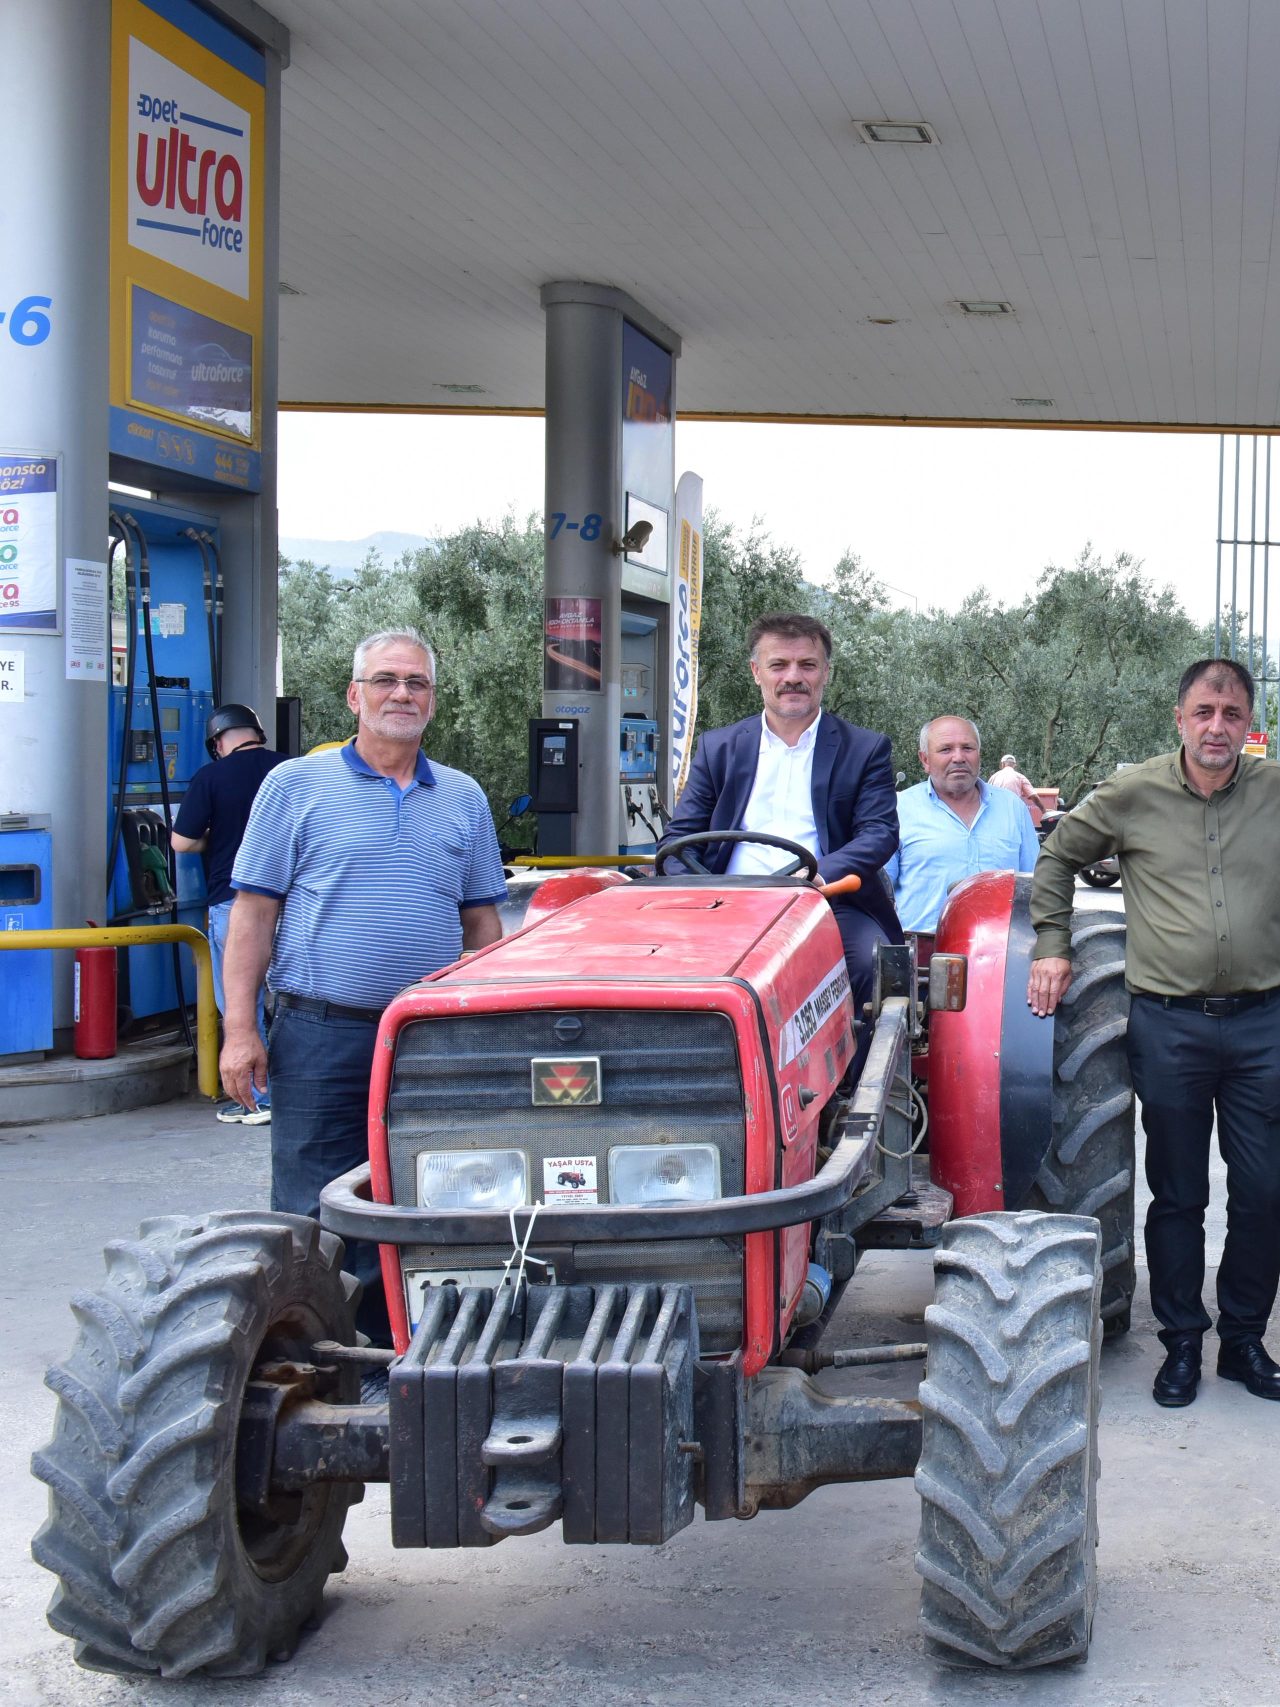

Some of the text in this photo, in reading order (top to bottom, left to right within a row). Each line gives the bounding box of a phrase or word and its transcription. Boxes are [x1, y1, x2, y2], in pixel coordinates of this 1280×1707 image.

[136, 126, 243, 222] ultra
[202, 217, 242, 253] force
[191, 362, 244, 383] ultraforce
[550, 512, 602, 541] 7-8
[547, 1160, 573, 1168] YAŞAR
